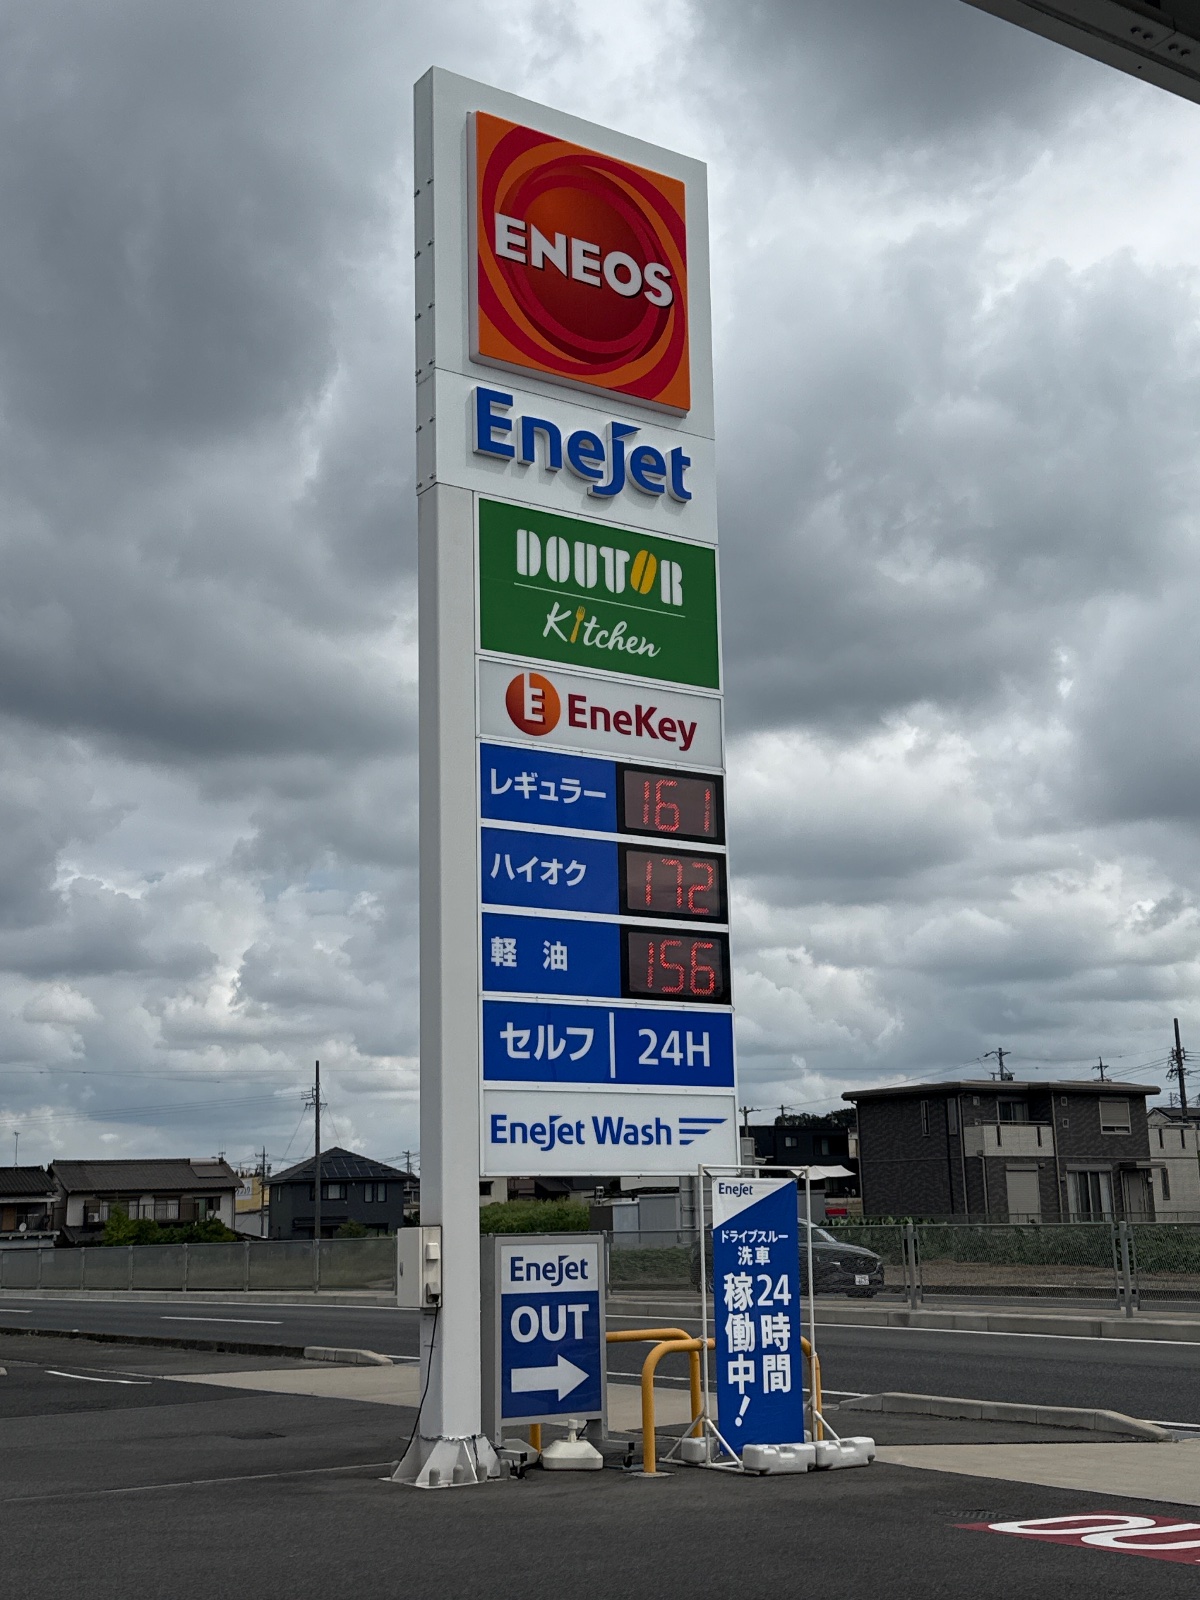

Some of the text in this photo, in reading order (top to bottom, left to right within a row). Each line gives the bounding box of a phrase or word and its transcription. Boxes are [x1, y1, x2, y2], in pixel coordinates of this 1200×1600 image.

[494, 212, 674, 309] ENEOS
[472, 386, 692, 502] Enejet
[516, 528, 683, 606] DOUTOR
[542, 601, 661, 658] Kitchen
[568, 693, 697, 751] EneKey
[490, 768, 711, 832] レギュラー 161
[490, 853, 714, 914] ハイオク 172
[490, 937, 715, 996] 軽油 156
[500, 1021, 711, 1068] セルフ 24H
[490, 1114, 672, 1152] Enejet Wash
[718, 1182, 754, 1197] Enejet
[721, 1230, 789, 1244] ドライブスルー
[737, 1246, 771, 1266] 洗車
[510, 1255, 589, 1287] Enejet
[510, 1304, 590, 1343] OUT
